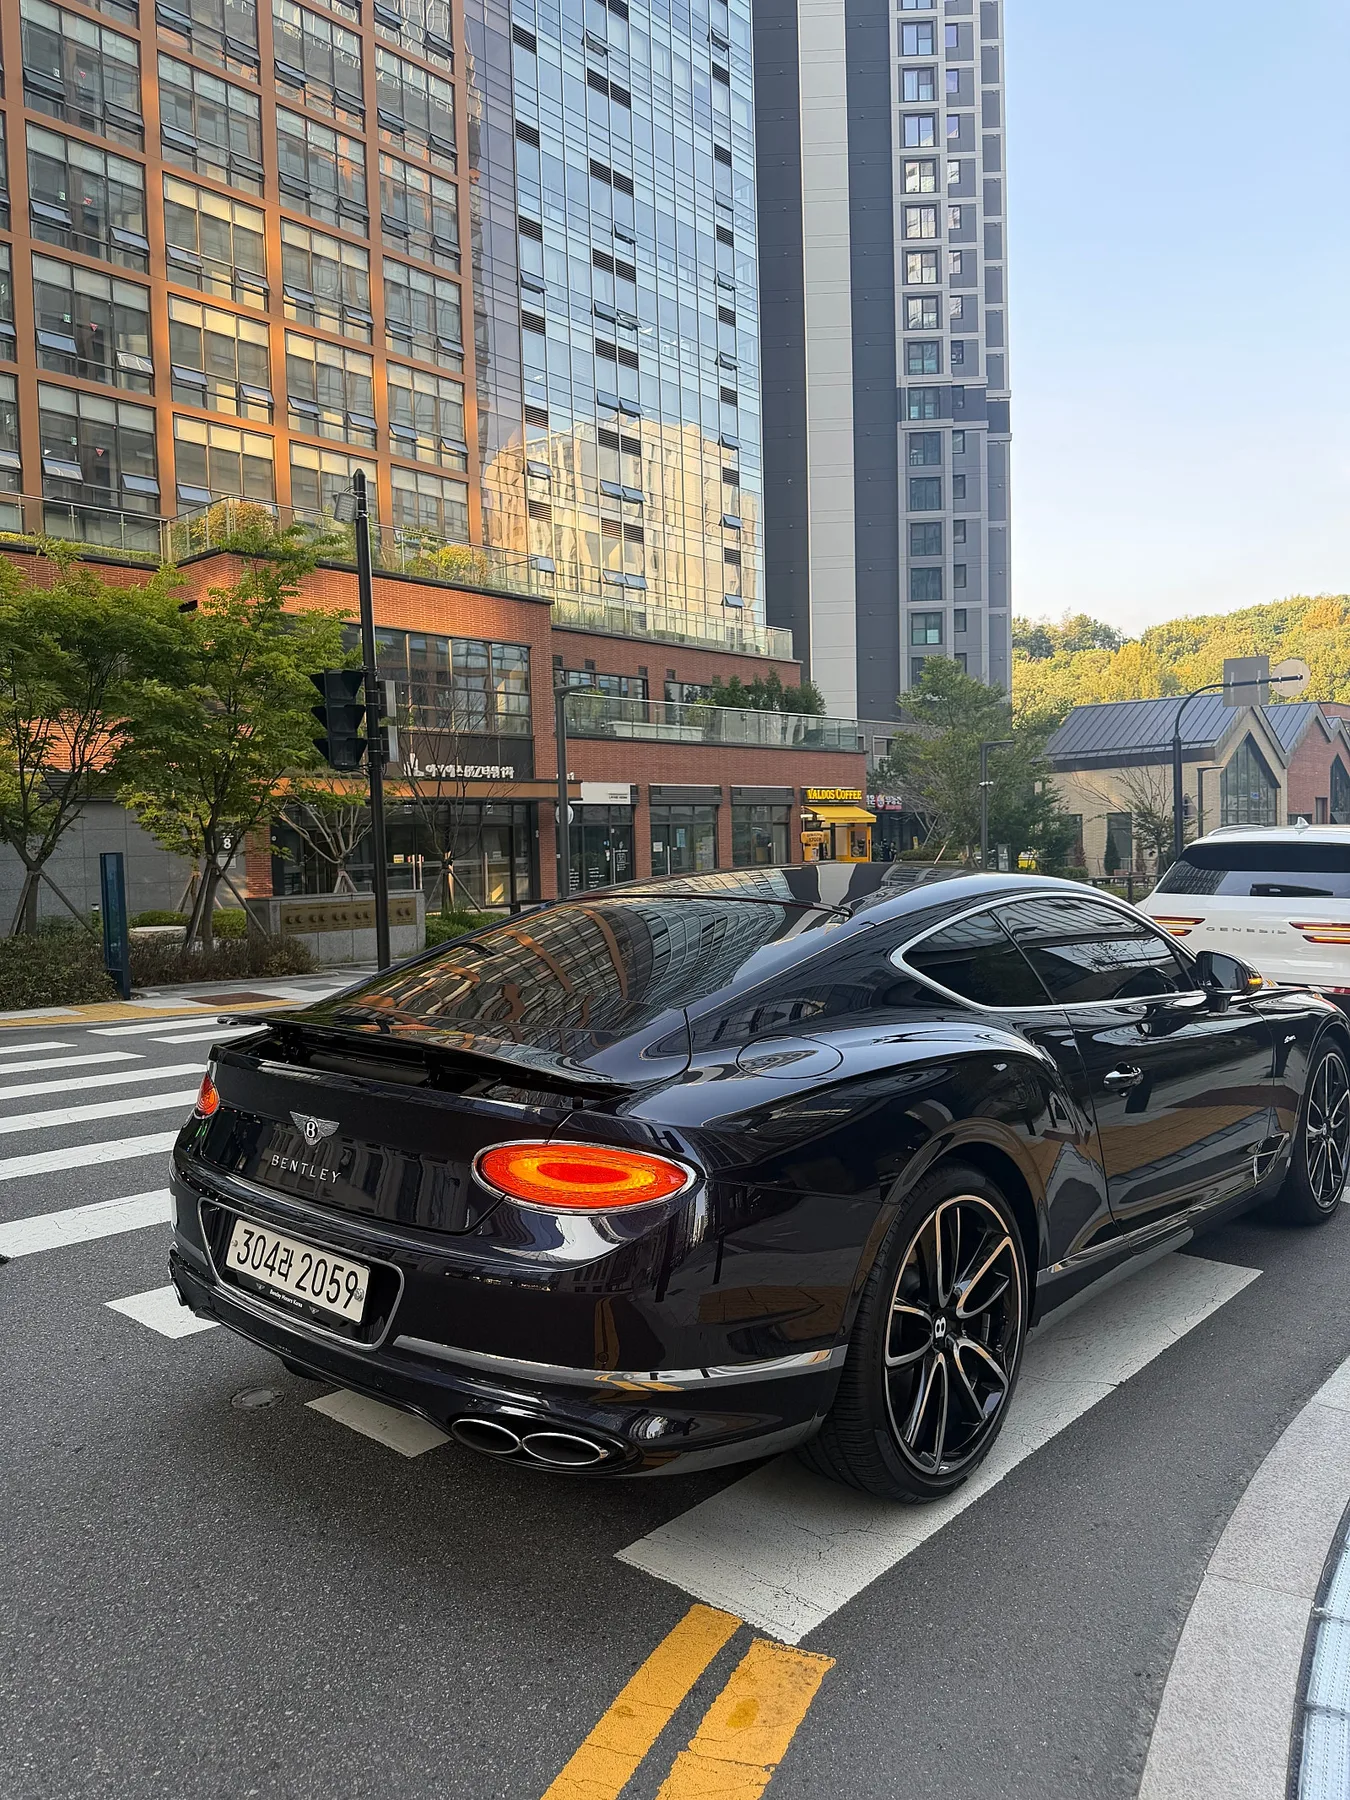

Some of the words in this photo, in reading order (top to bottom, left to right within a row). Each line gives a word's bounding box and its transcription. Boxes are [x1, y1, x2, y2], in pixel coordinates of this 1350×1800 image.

[836, 788, 862, 800] COFFEE
[223, 837, 232, 850] 8
[1206, 926, 1287, 935] GENESIS
[271, 1154, 341, 1184] BENTLEY
[236, 1228, 294, 1282] 304라
[295, 1252, 359, 1309] 2059
